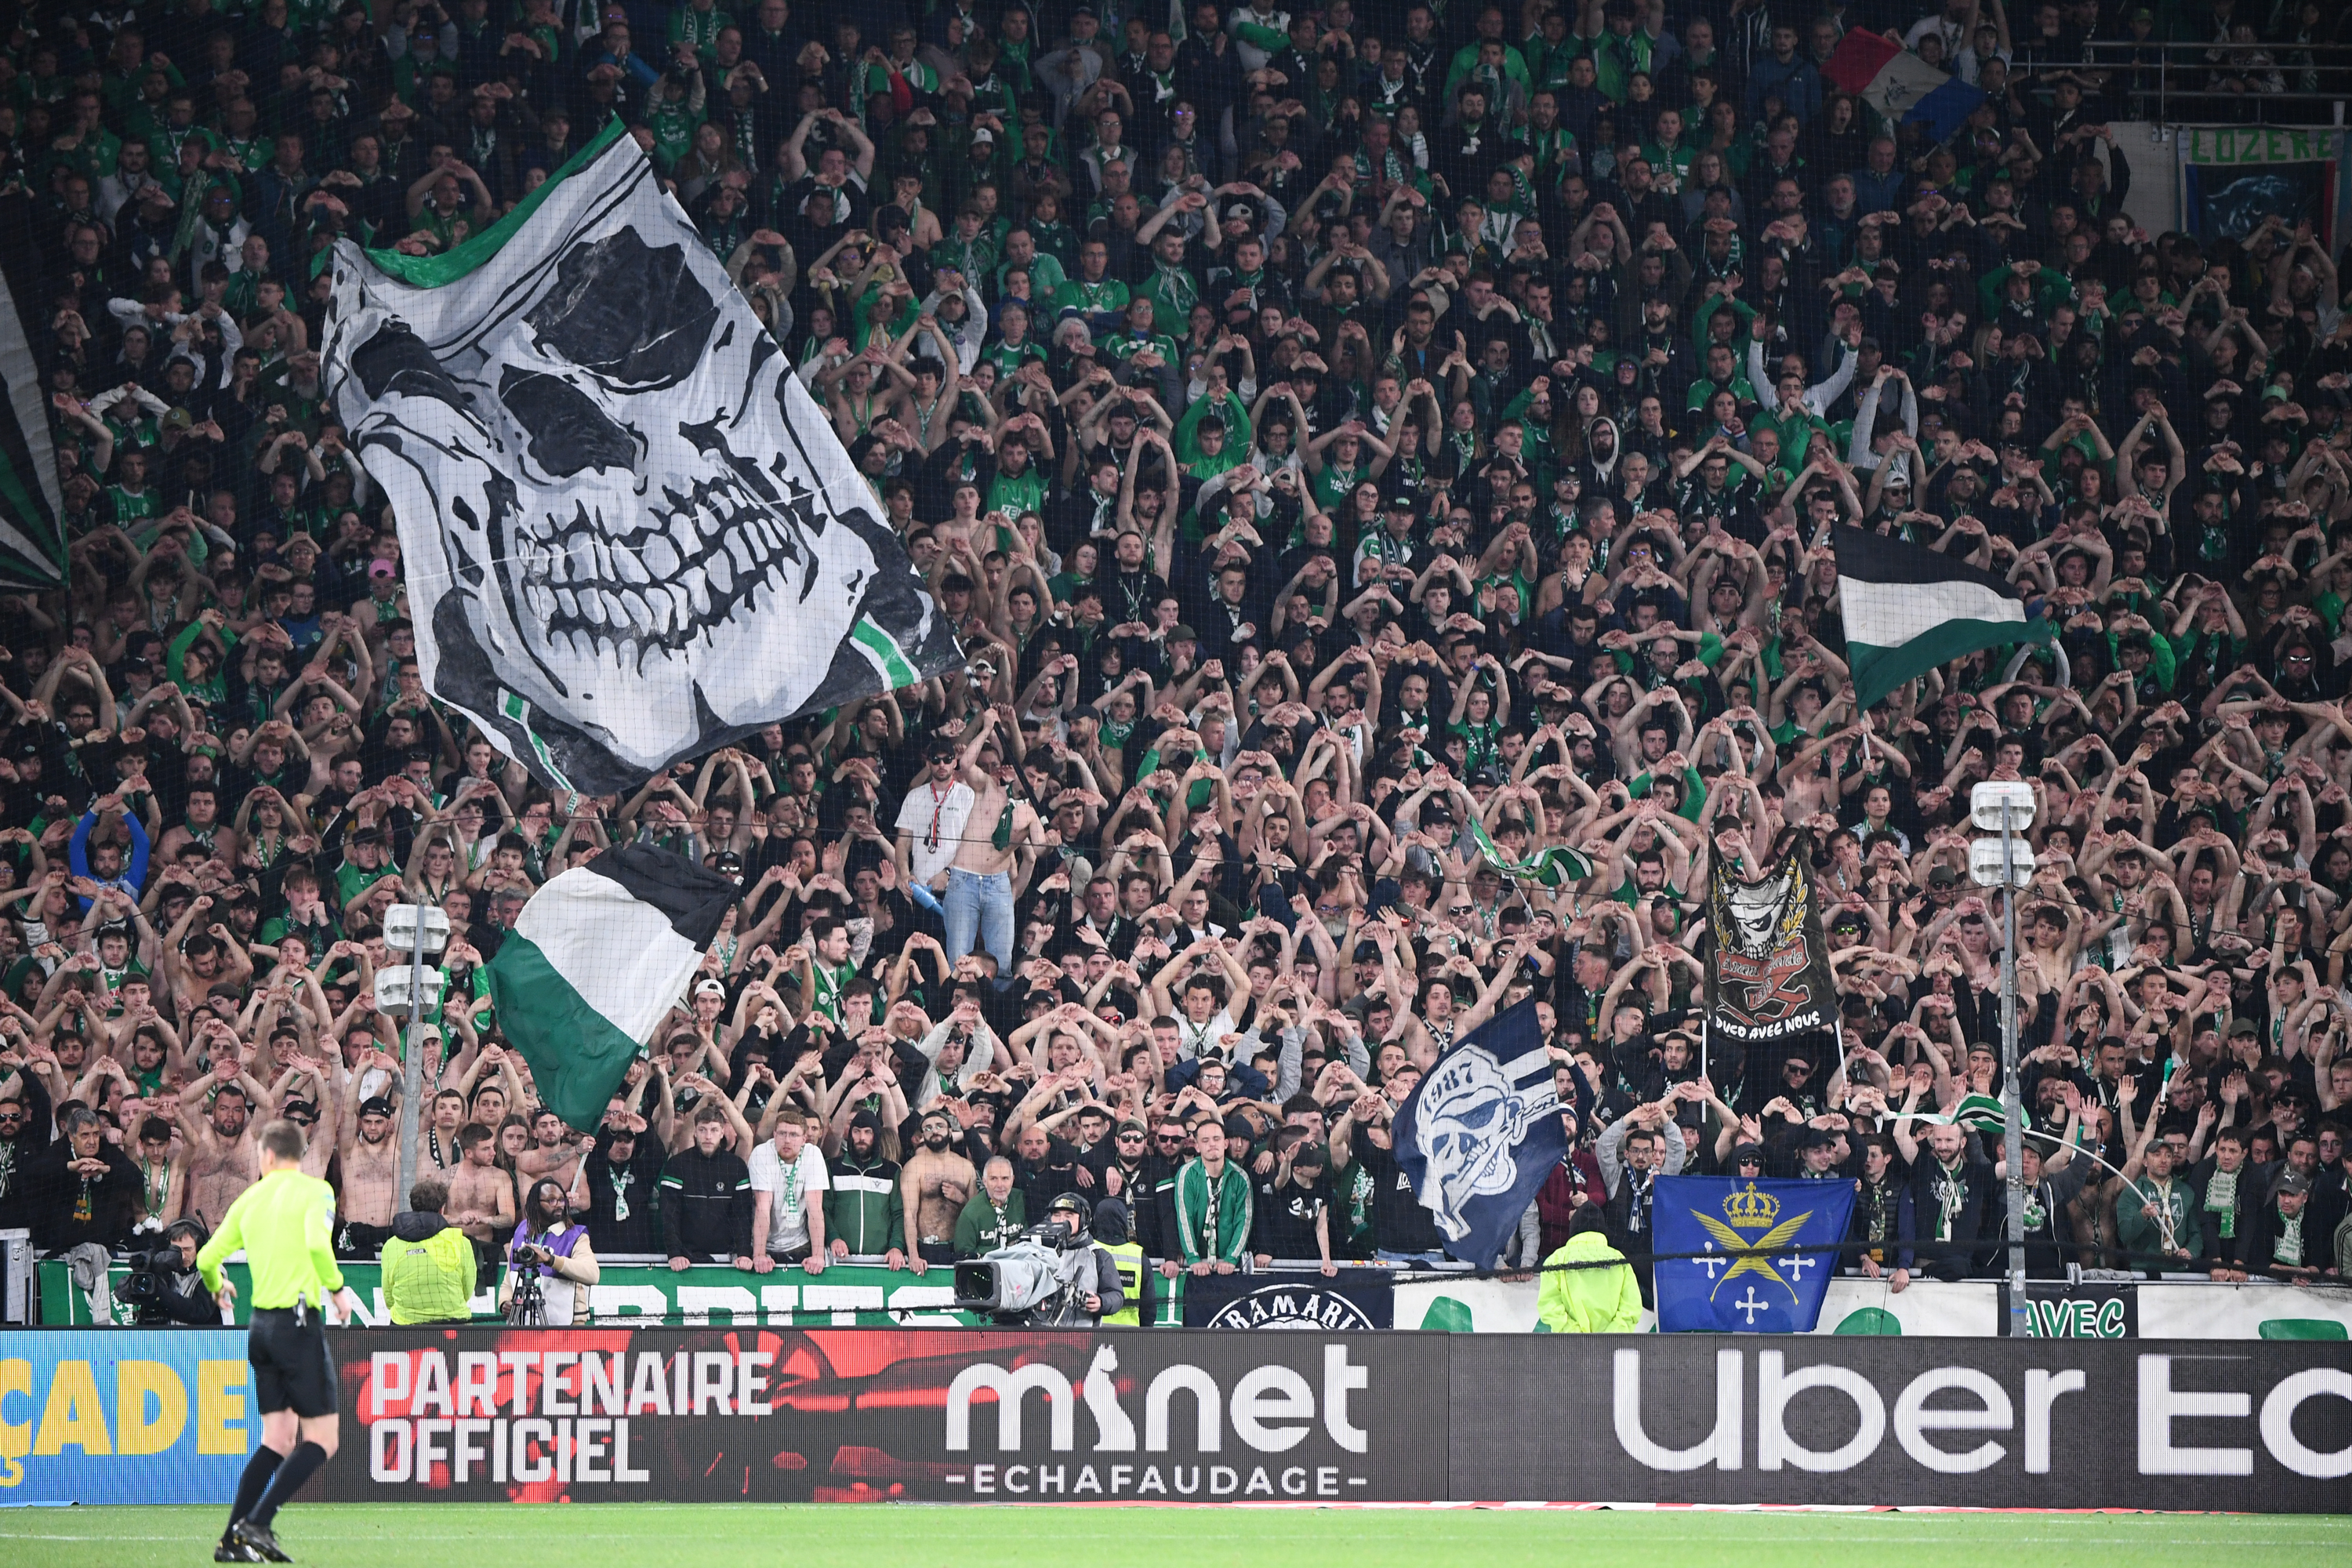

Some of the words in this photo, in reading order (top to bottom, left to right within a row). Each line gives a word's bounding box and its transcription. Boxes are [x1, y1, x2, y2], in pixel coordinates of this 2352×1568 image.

[2190, 129, 2334, 163] LOZERE
[1748, 1025, 1783, 1040] AVEC
[1785, 1011, 1821, 1033] NOUS
[1424, 1061, 1473, 1113] 1987
[371, 1351, 772, 1417] PARTENAIRE
[1613, 1348, 2086, 1474] Uber
[371, 1417, 650, 1483] OFFICIEL
